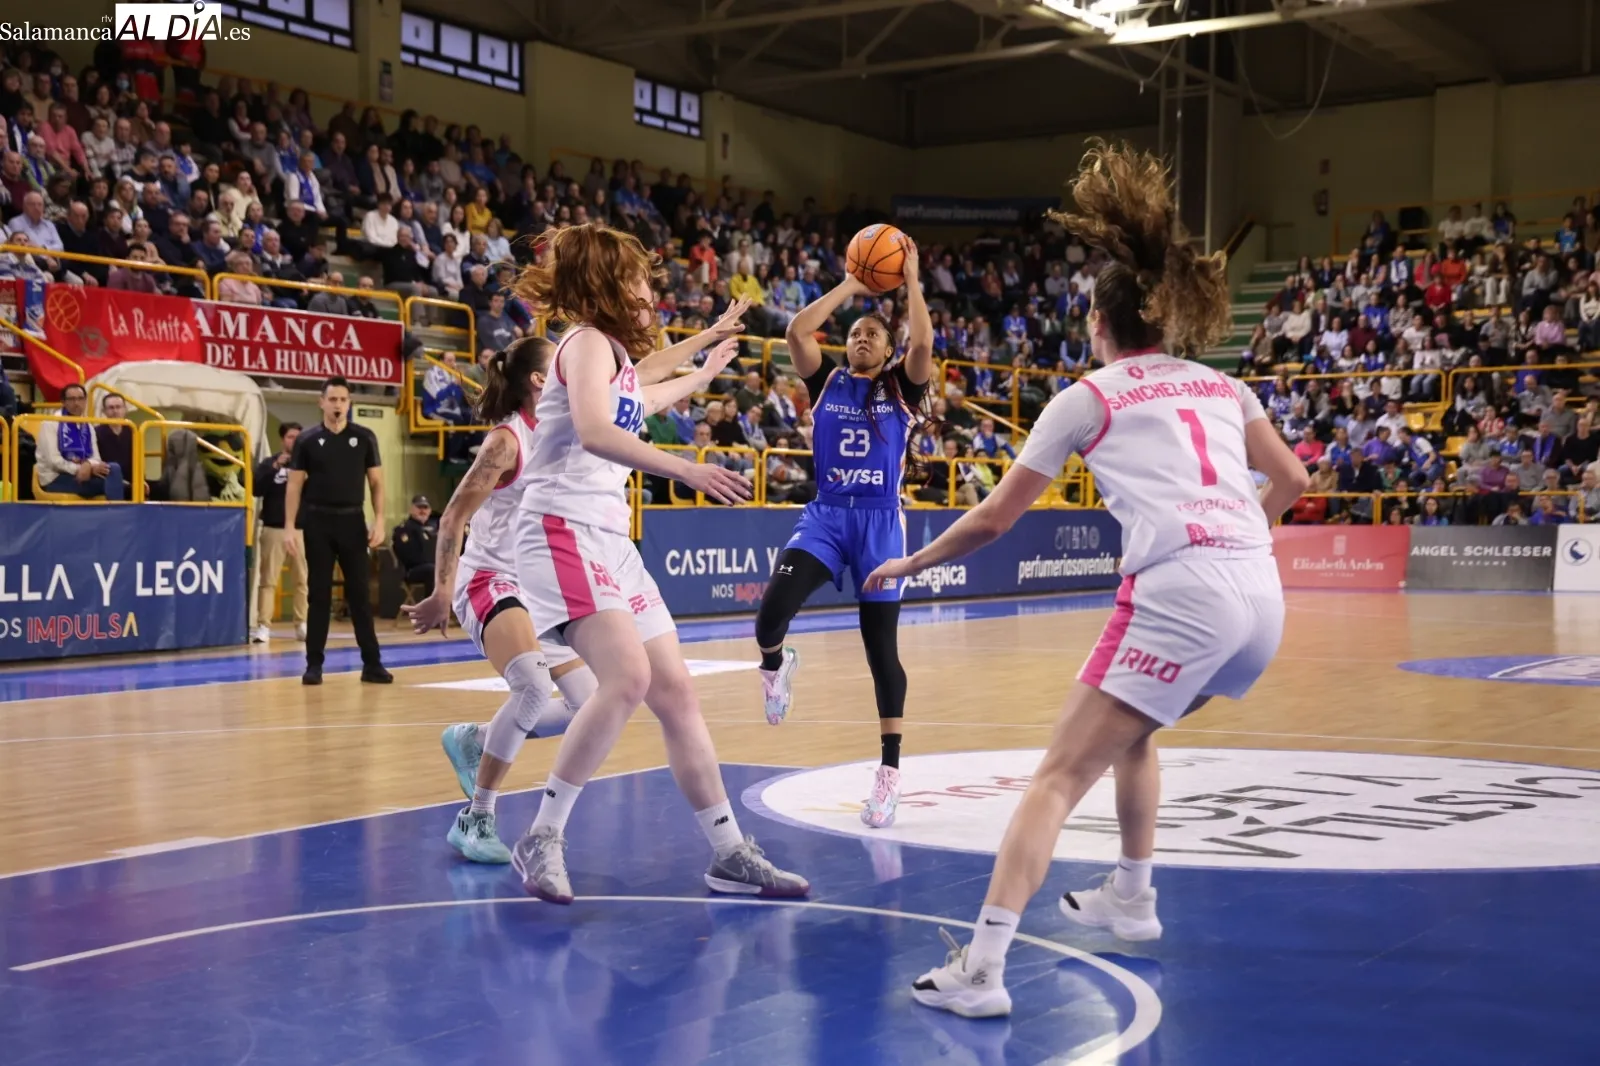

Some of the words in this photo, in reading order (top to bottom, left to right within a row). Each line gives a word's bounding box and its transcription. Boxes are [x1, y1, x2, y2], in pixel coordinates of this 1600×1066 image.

[108, 304, 129, 336] La
[132, 307, 194, 343] Ranita
[205, 342, 236, 368] DE
[242, 347, 269, 371] LA
[275, 348, 394, 379] HUMANIDAD
[620, 366, 635, 393] 13
[840, 428, 871, 457] 23
[1176, 408, 1217, 487] 1
[665, 547, 758, 576] CASTILLA
[766, 547, 779, 577] Y
[1293, 558, 1346, 570] Elizabeth
[1349, 558, 1385, 570] Arden
[1411, 545, 1457, 556] ANGEL
[1463, 545, 1552, 557] SCHLESSER
[93, 562, 119, 606] Y
[136, 547, 224, 597] LEÓN
[712, 583, 734, 599] NOS
[27, 611, 139, 648] IMPULSA
